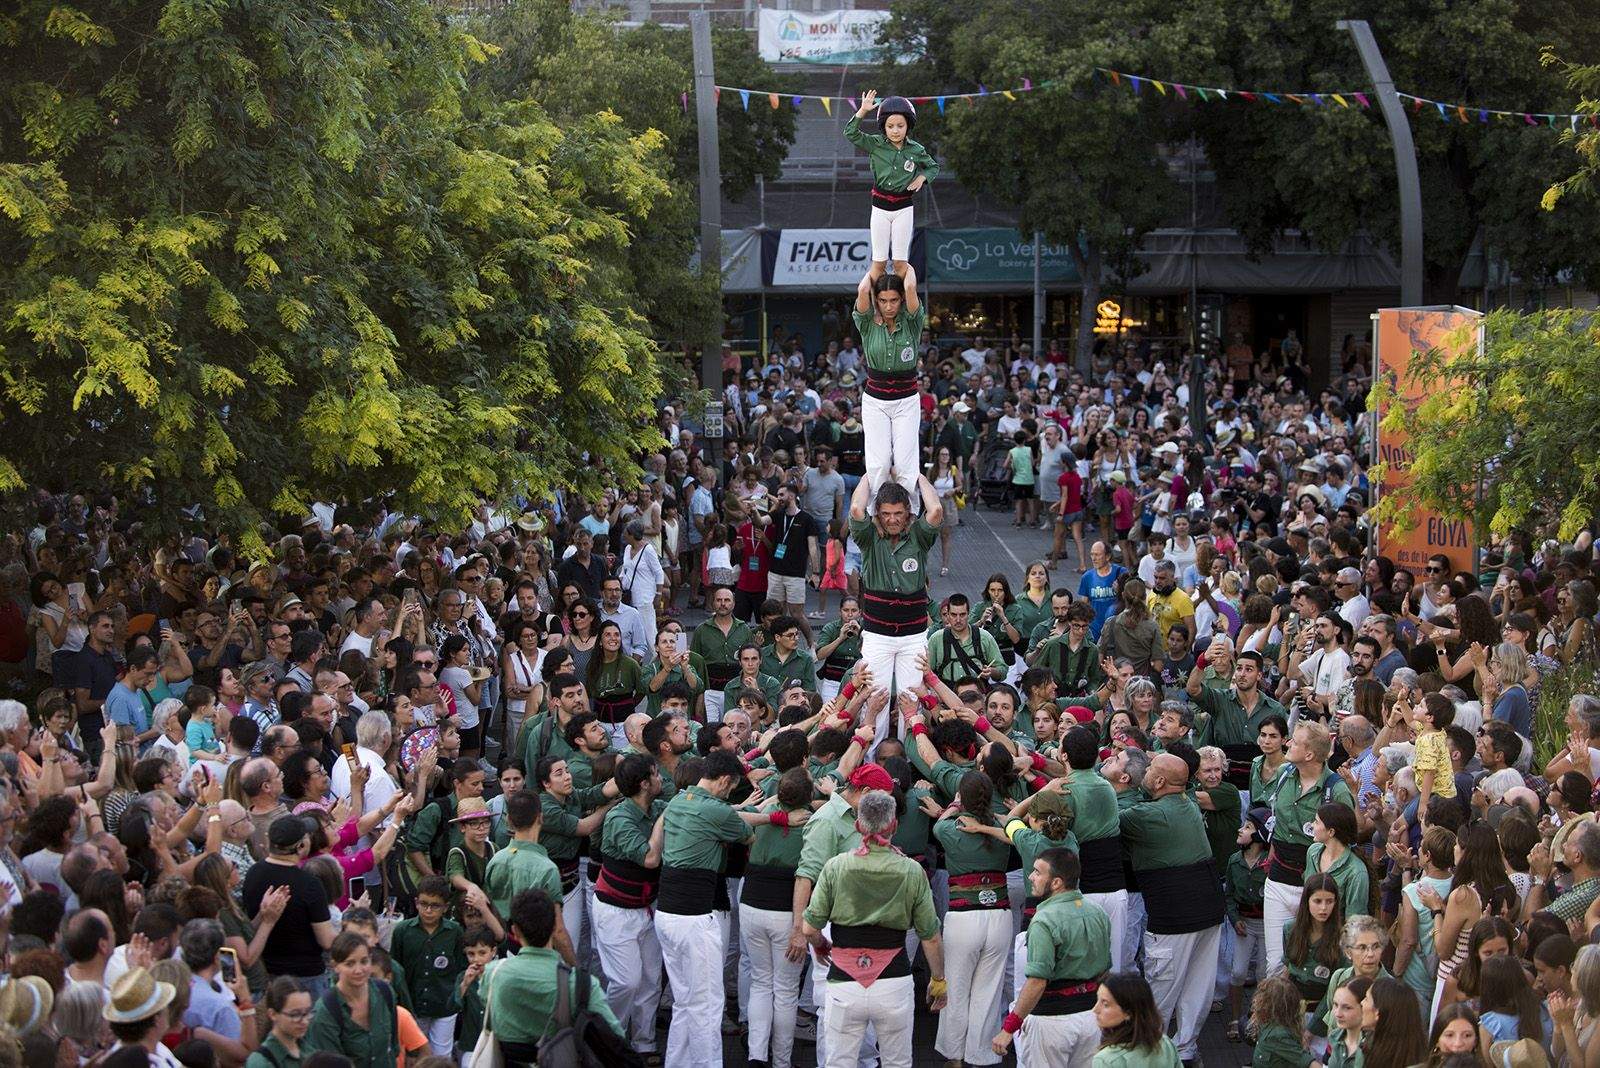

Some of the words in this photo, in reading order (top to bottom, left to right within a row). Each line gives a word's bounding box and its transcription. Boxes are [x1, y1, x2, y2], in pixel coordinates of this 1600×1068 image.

[810, 24, 837, 34] MON
[790, 242, 868, 262] FIATC
[985, 243, 1005, 256] La
[788, 264, 868, 273] ASSEGURAN
[1427, 517, 1467, 547] GOYA
[1411, 551, 1420, 562] de
